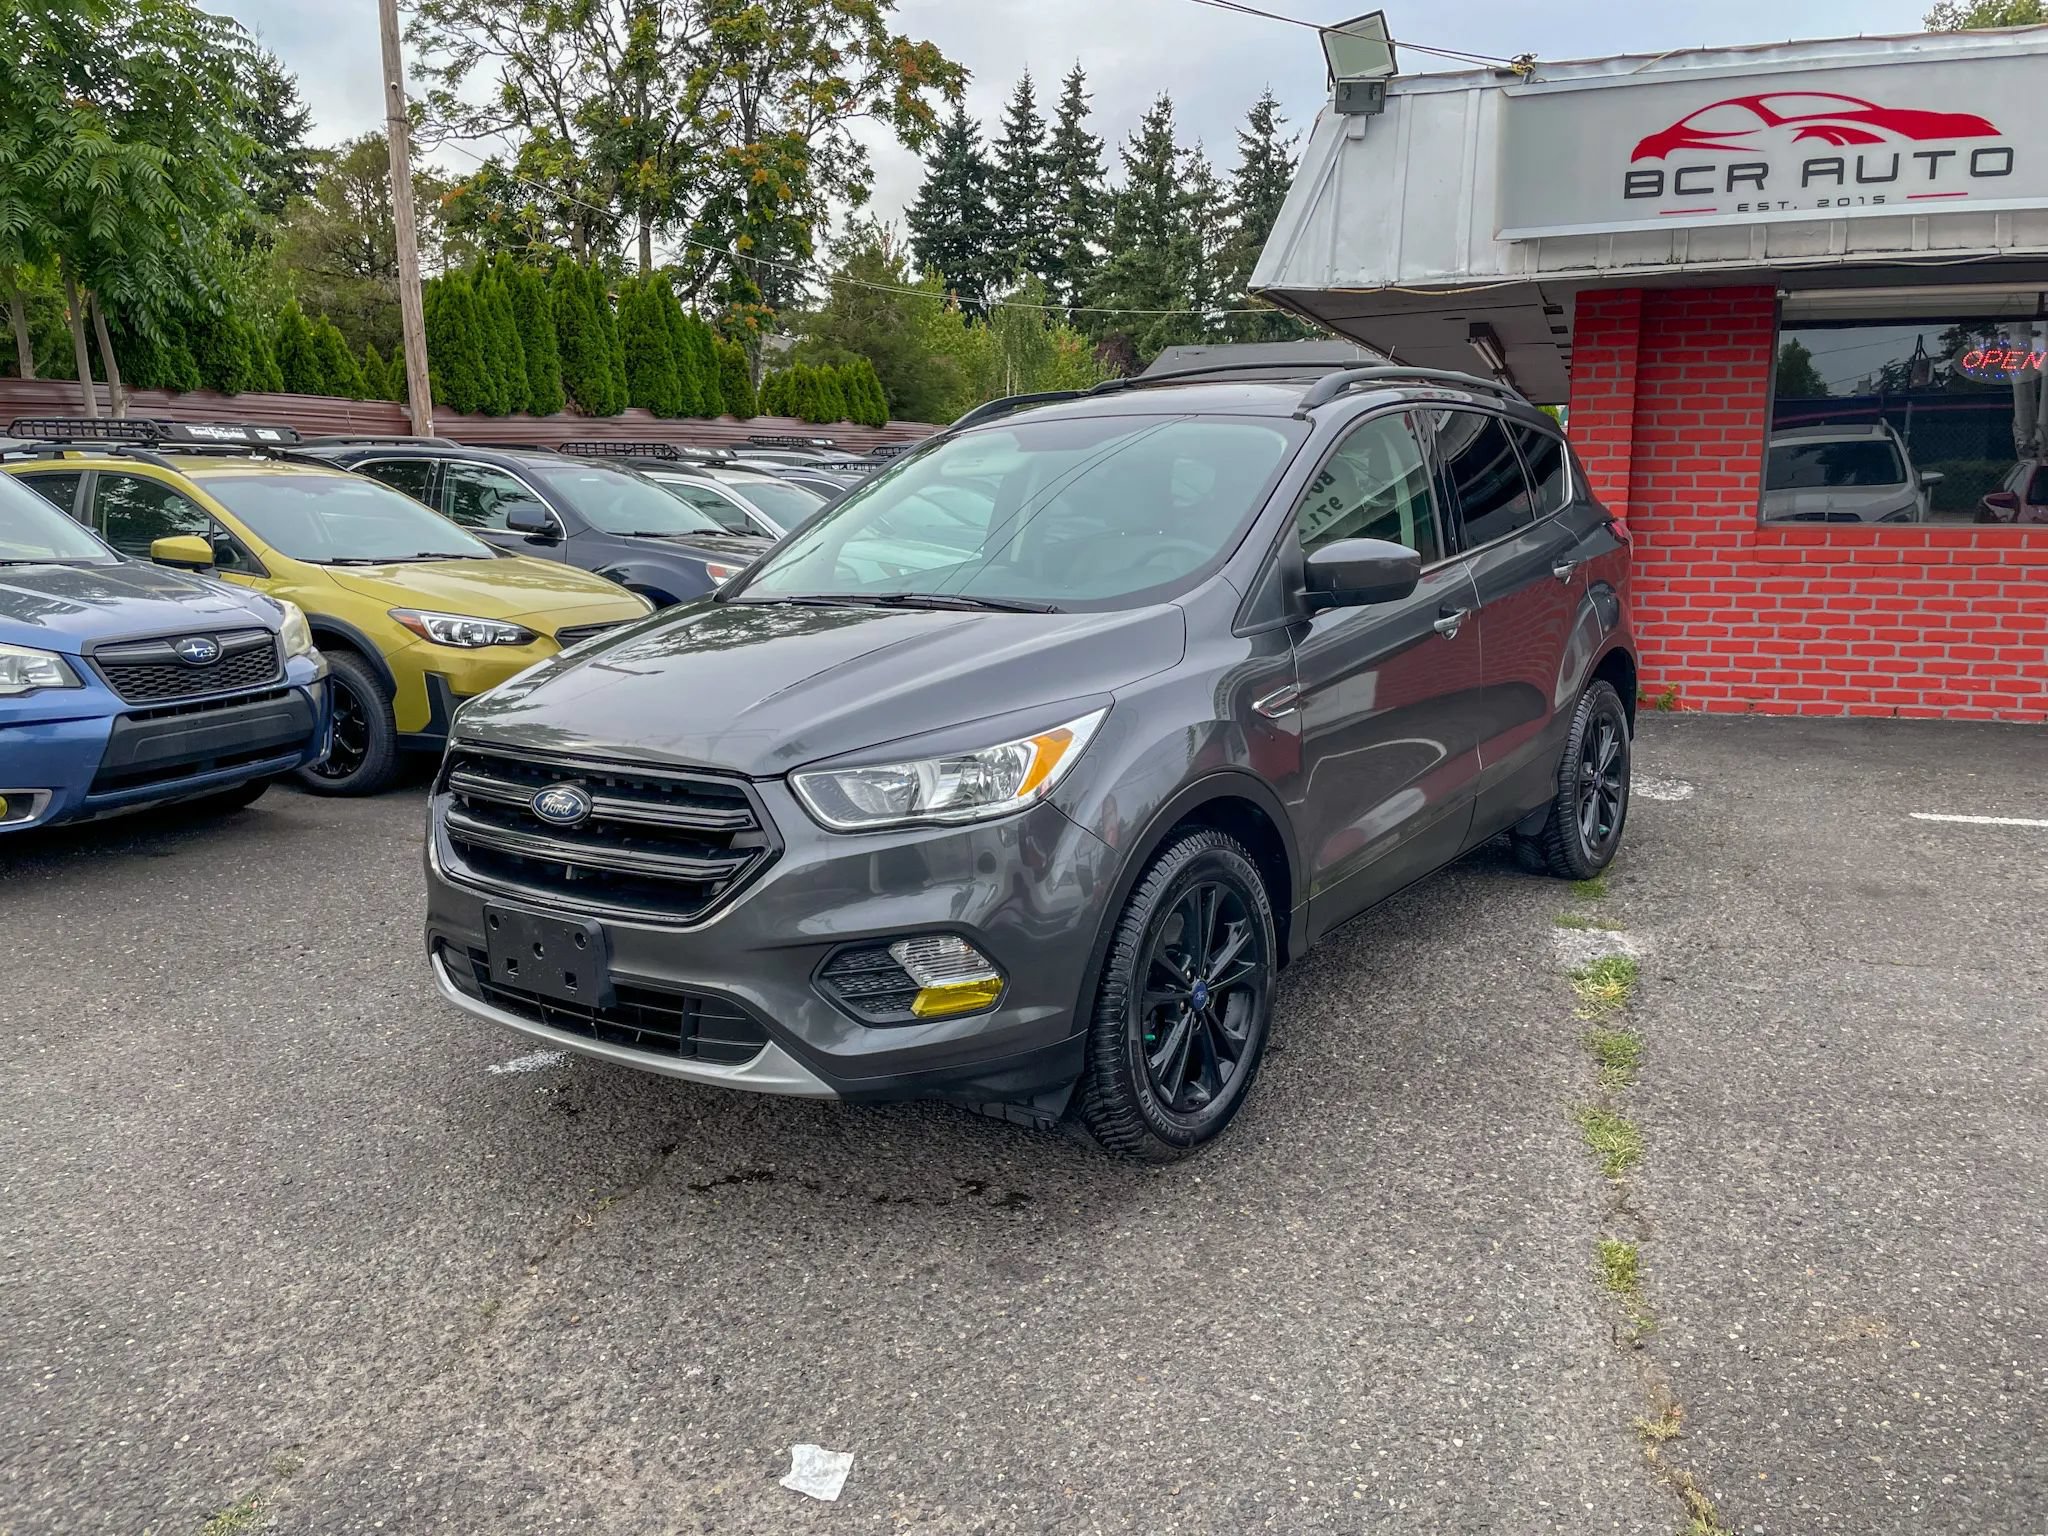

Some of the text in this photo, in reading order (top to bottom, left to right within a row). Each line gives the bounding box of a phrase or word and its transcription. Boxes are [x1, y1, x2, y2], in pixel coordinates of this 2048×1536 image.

[1623, 146, 2014, 199] BCR AUTO
[1737, 195, 1885, 212] EST. 2015
[1961, 350, 2047, 369] OPEN
[541, 793, 573, 815] Ford
